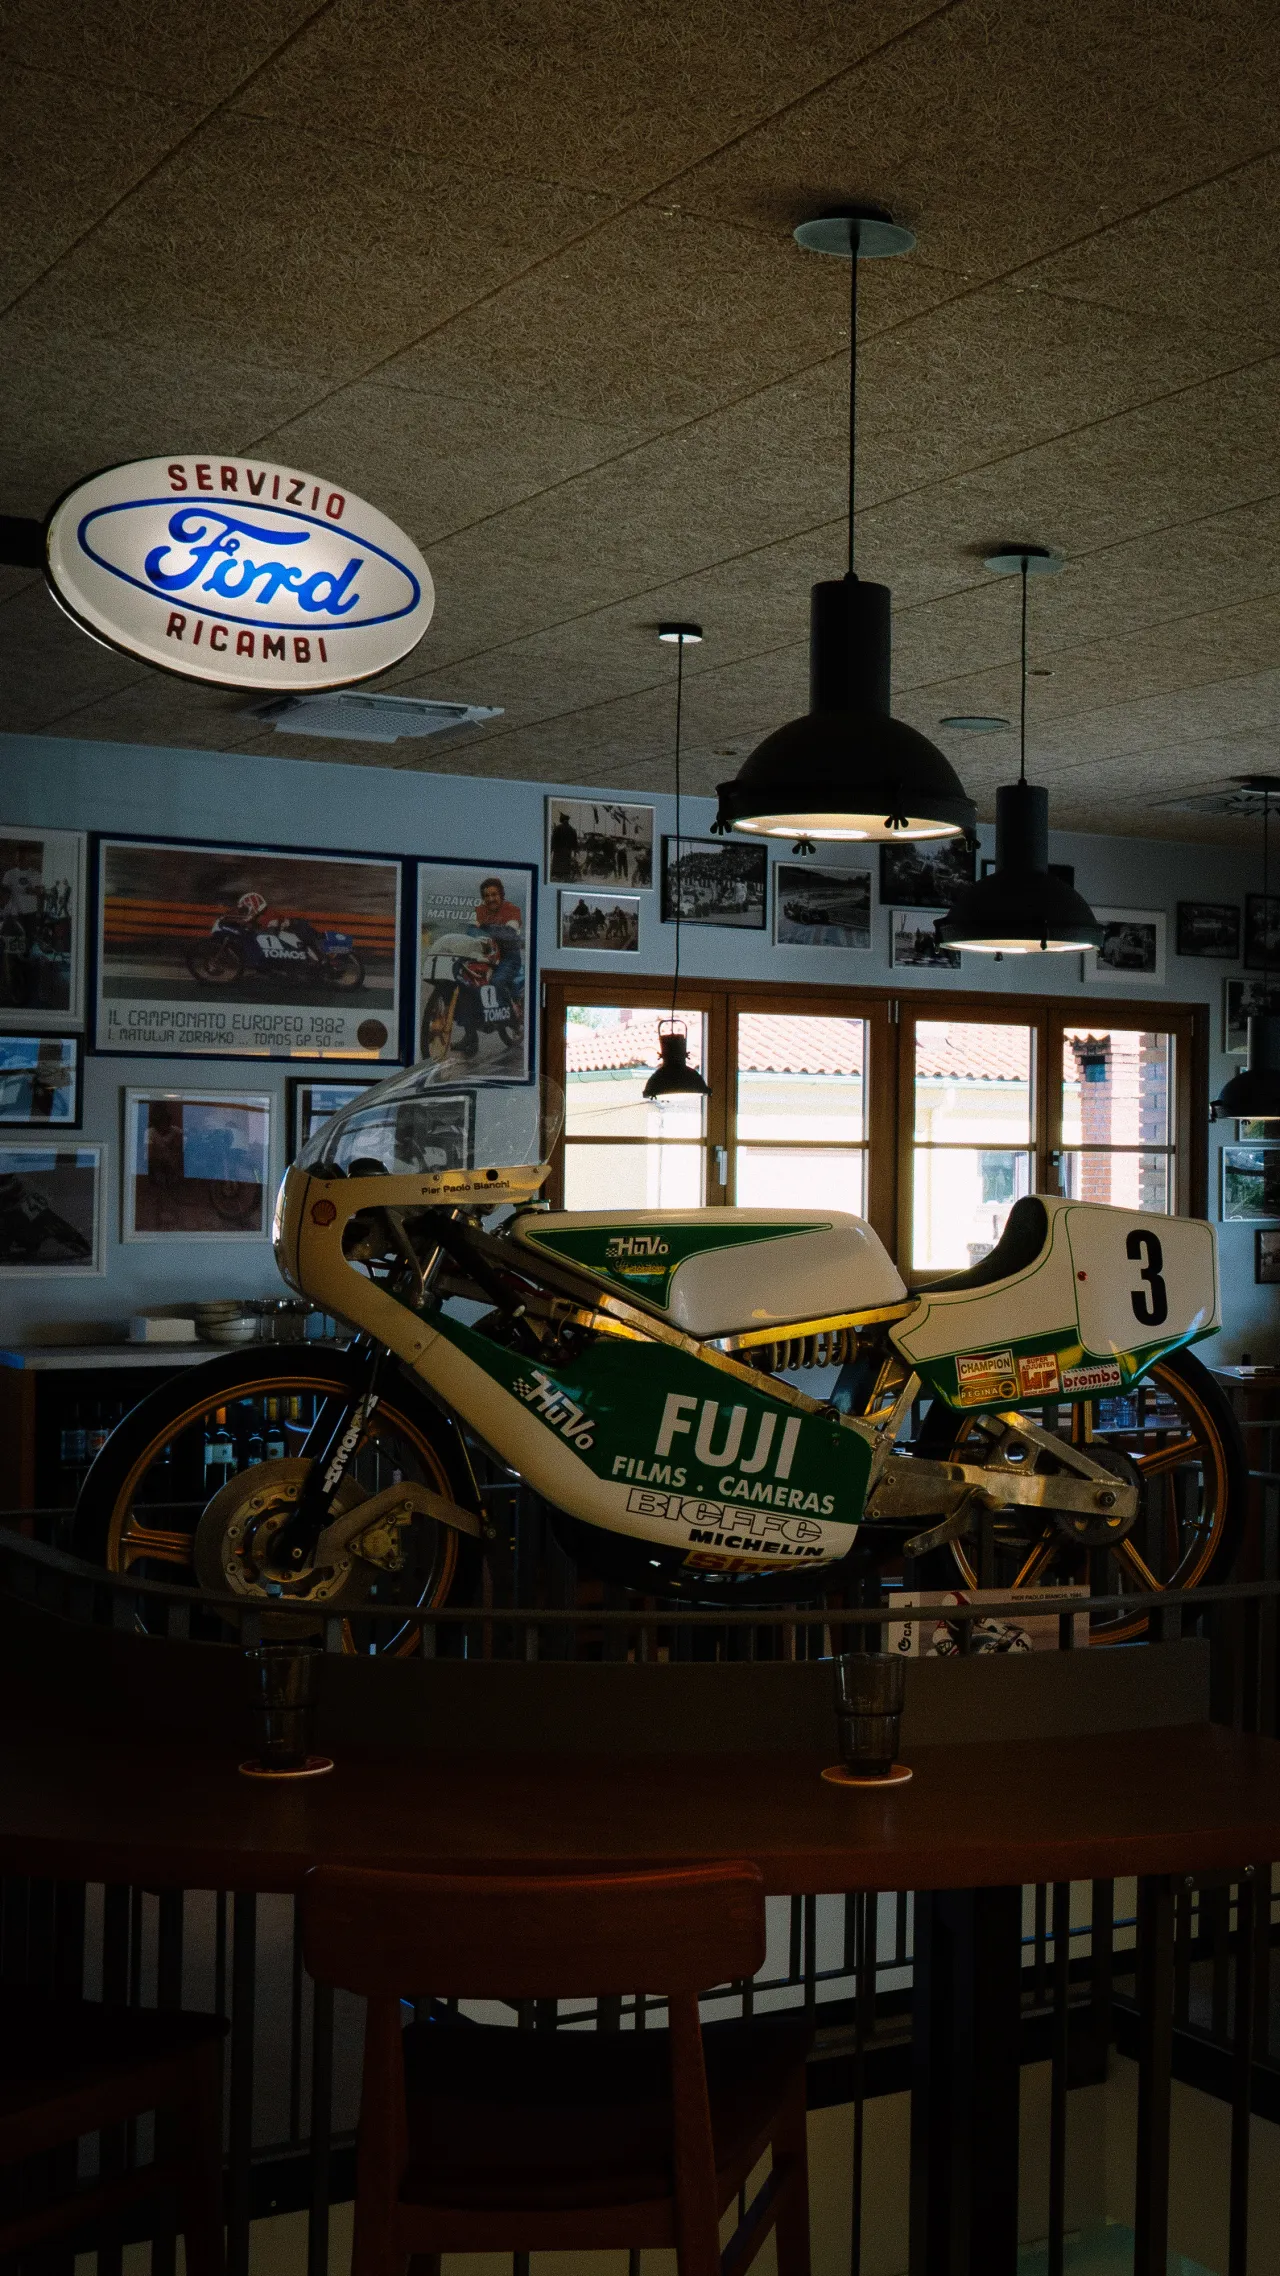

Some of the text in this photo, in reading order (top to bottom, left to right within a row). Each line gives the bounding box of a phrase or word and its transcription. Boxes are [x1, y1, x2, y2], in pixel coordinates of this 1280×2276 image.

[167, 464, 347, 521] SERVIZIO
[144, 507, 364, 616] Ford
[166, 611, 328, 664] RICAMBI
[427, 894, 482, 907] ZDRAVKO
[264, 949, 307, 960] TOMOS
[108, 1009, 345, 1034] IL CAMPIONATO EUROPEO 1982
[483, 1006, 511, 1023] TOMOS
[254, 1032, 292, 1046] TOMOS
[296, 1034, 312, 1047] GP
[316, 1035, 331, 1048] 50
[421, 1180, 510, 1195] Pier Paolo Bianchi
[1126, 1229, 1168, 1326] 3
[960, 1358, 1010, 1375] CHAMPION
[1022, 1361, 1055, 1371] ADJUSTER
[1027, 1356, 1048, 1364] SUPER
[1063, 1369, 1120, 1388] brembo
[961, 1387, 999, 1399] REGINA
[653, 1392, 802, 1480] FUJI
[611, 1454, 836, 1516] FILMS CAMERAS
[689, 1528, 825, 1557] MICHELIN
